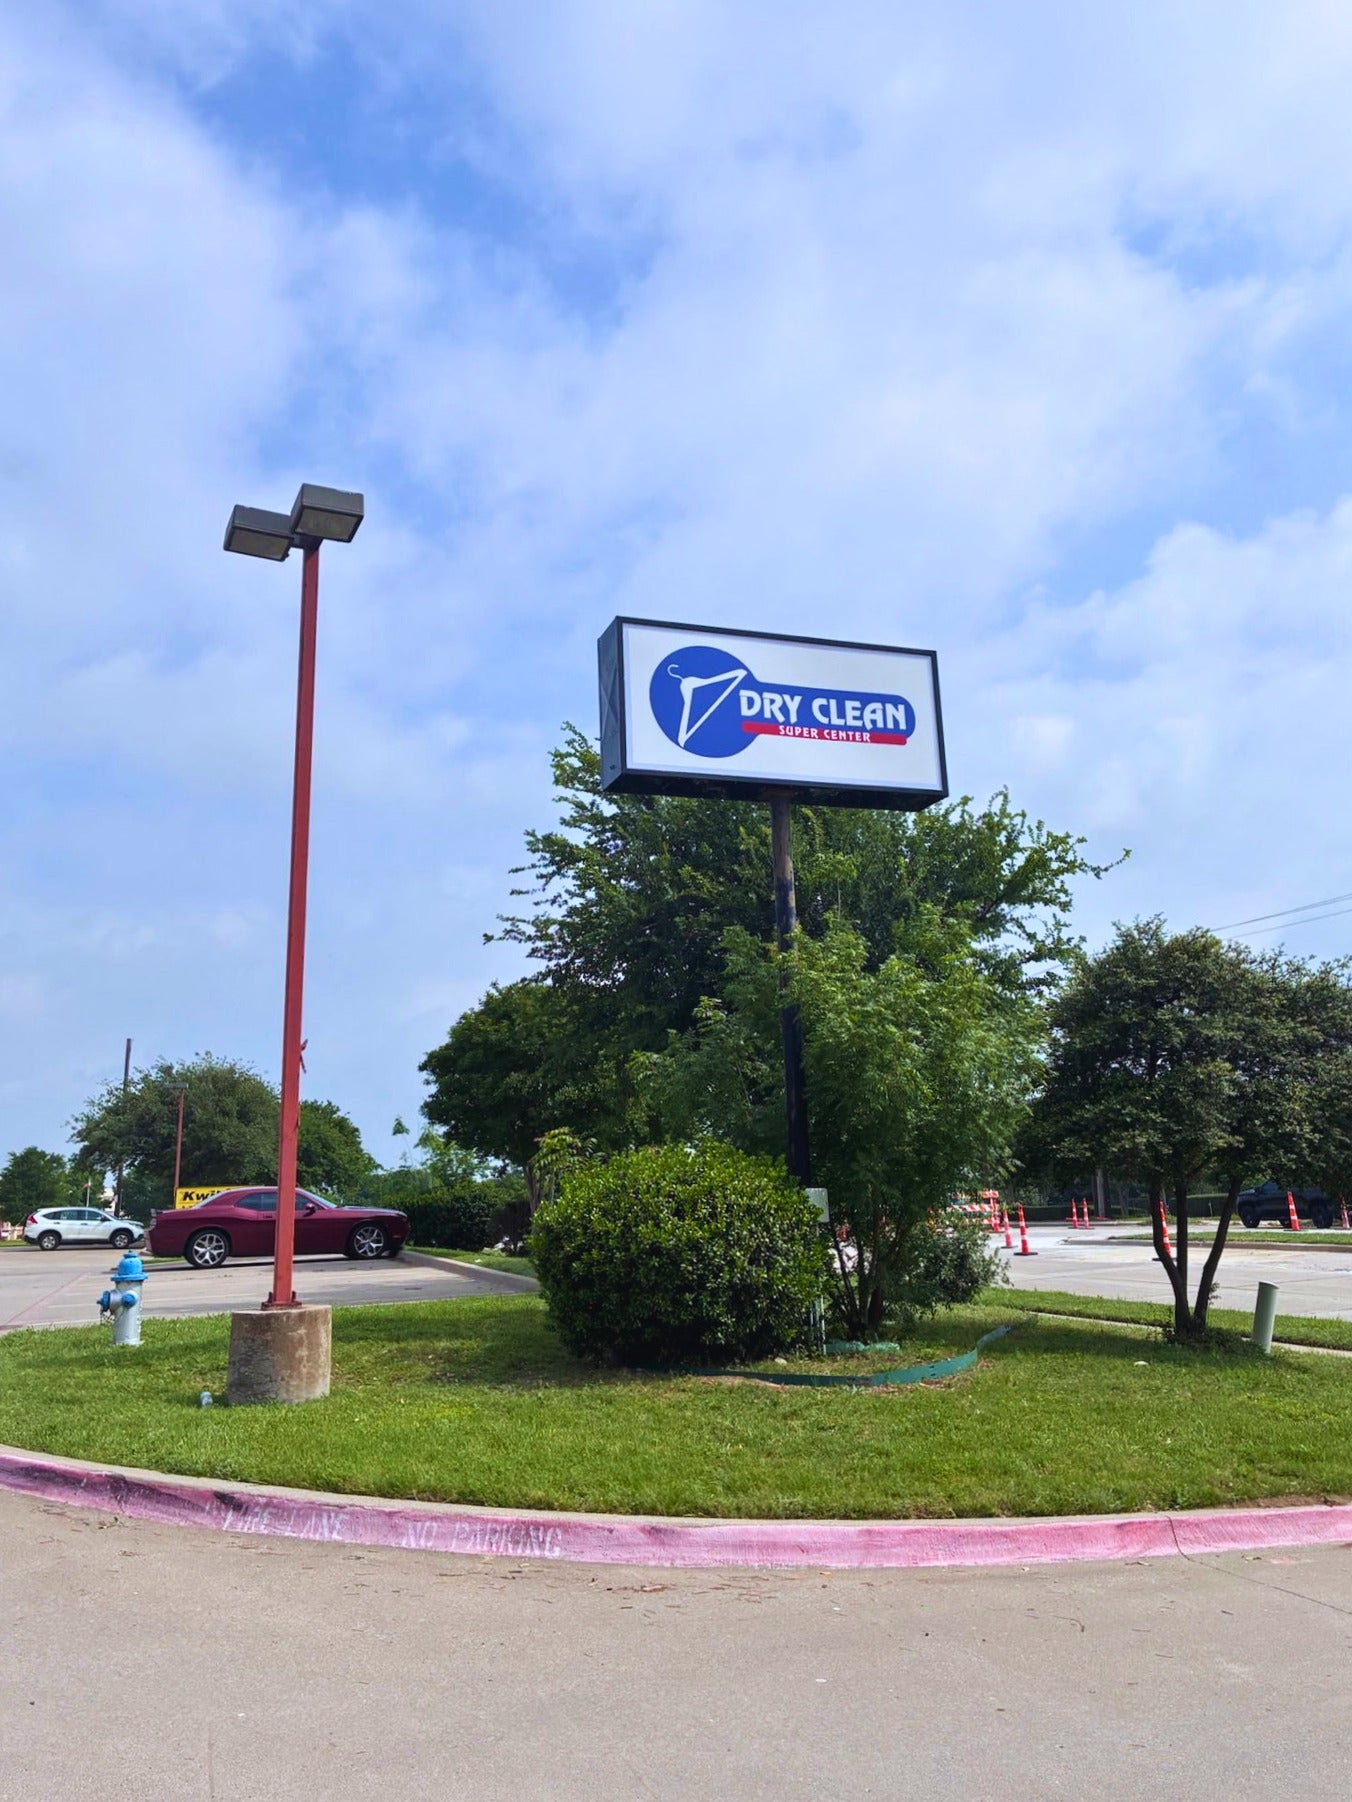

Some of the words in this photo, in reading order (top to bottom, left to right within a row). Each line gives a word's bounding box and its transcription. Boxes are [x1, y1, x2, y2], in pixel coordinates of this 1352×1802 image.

[739, 689, 802, 724] DRY
[811, 698, 906, 730] CLEAN
[779, 725, 819, 739] SUPER
[823, 729, 871, 742] CENTER
[401, 1521, 437, 1548] NO
[451, 1521, 562, 1557] PARKING
